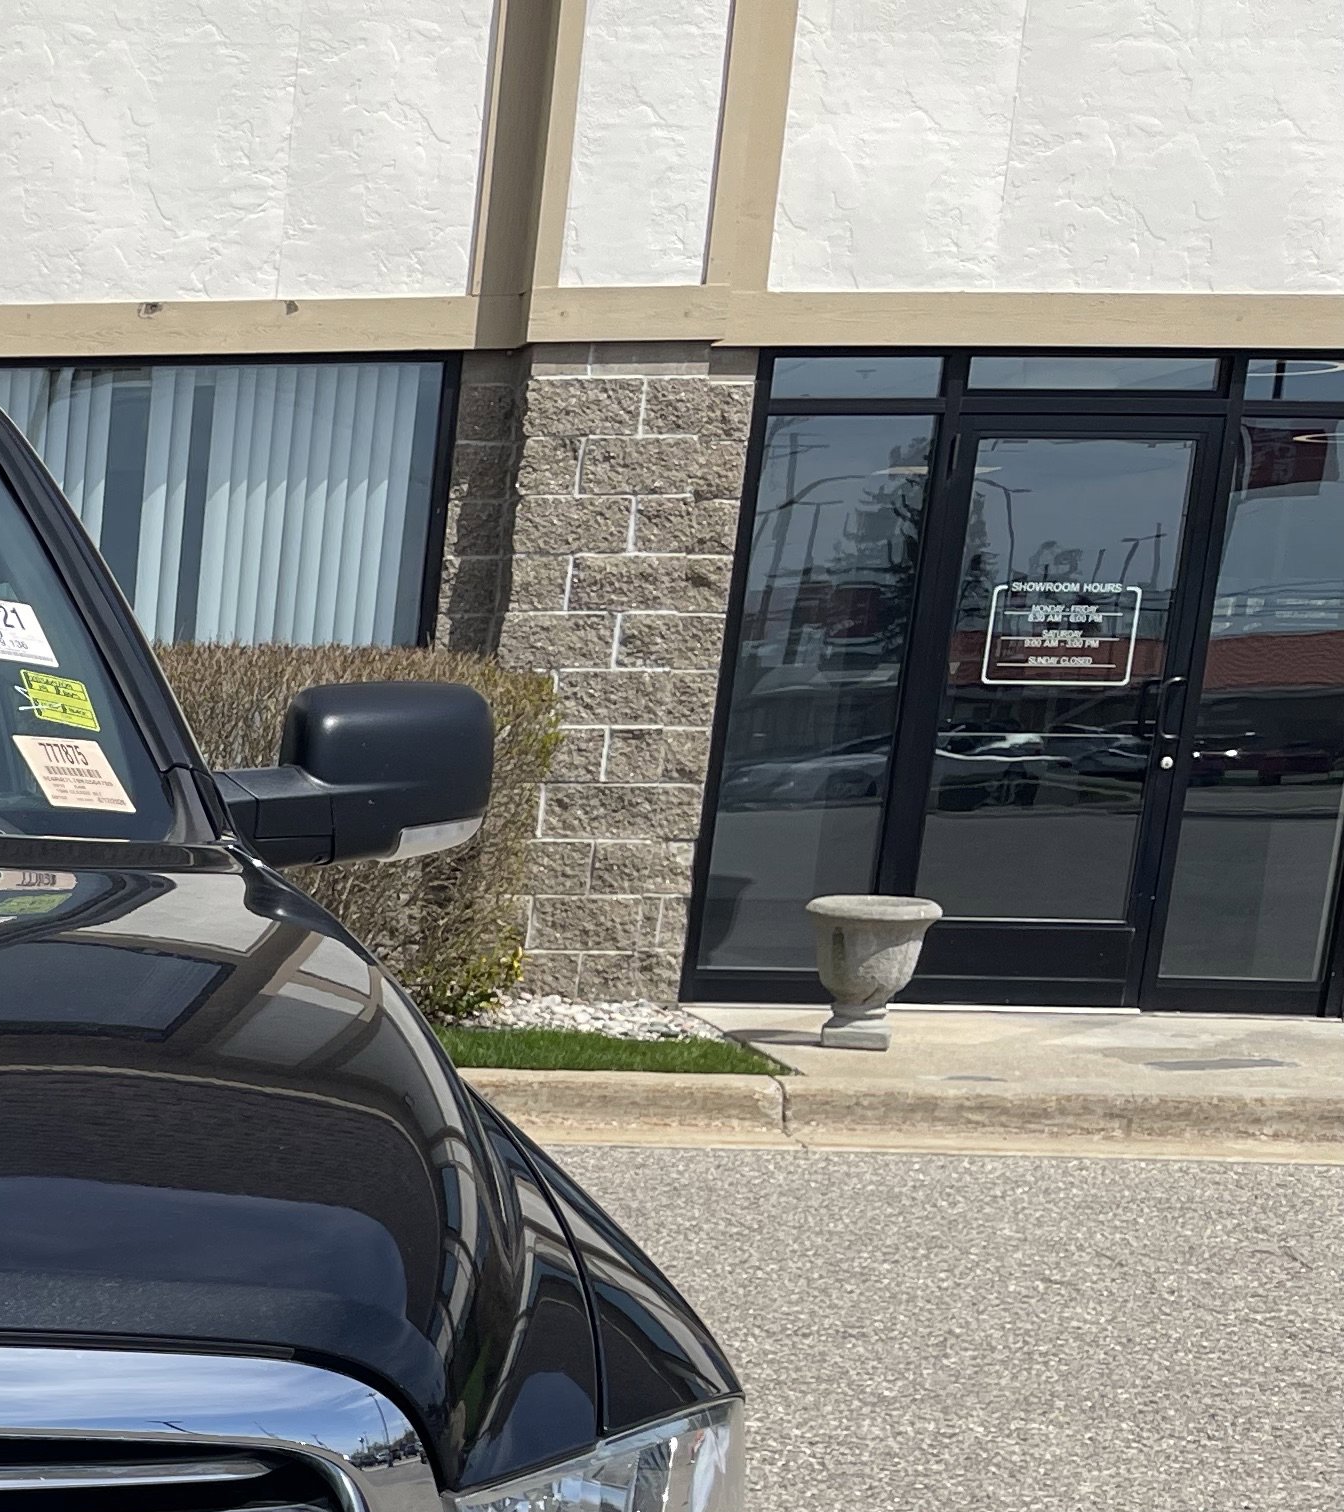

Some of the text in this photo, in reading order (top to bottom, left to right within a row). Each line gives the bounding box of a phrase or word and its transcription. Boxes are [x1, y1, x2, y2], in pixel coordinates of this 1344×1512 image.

[1011, 582, 1122, 593] SHOWROOM HOURS
[1031, 605, 1065, 613] MONDAY
[1070, 605, 1099, 613] FRIDAY
[1046, 614, 1062, 622] AM
[1088, 614, 1103, 622] PM
[1042, 630, 1083, 638] SATURDAY
[1084, 640, 1100, 648] PM
[1028, 656, 1093, 665] SUNDAY CLOSED
[38, 742, 89, 766] 777875
